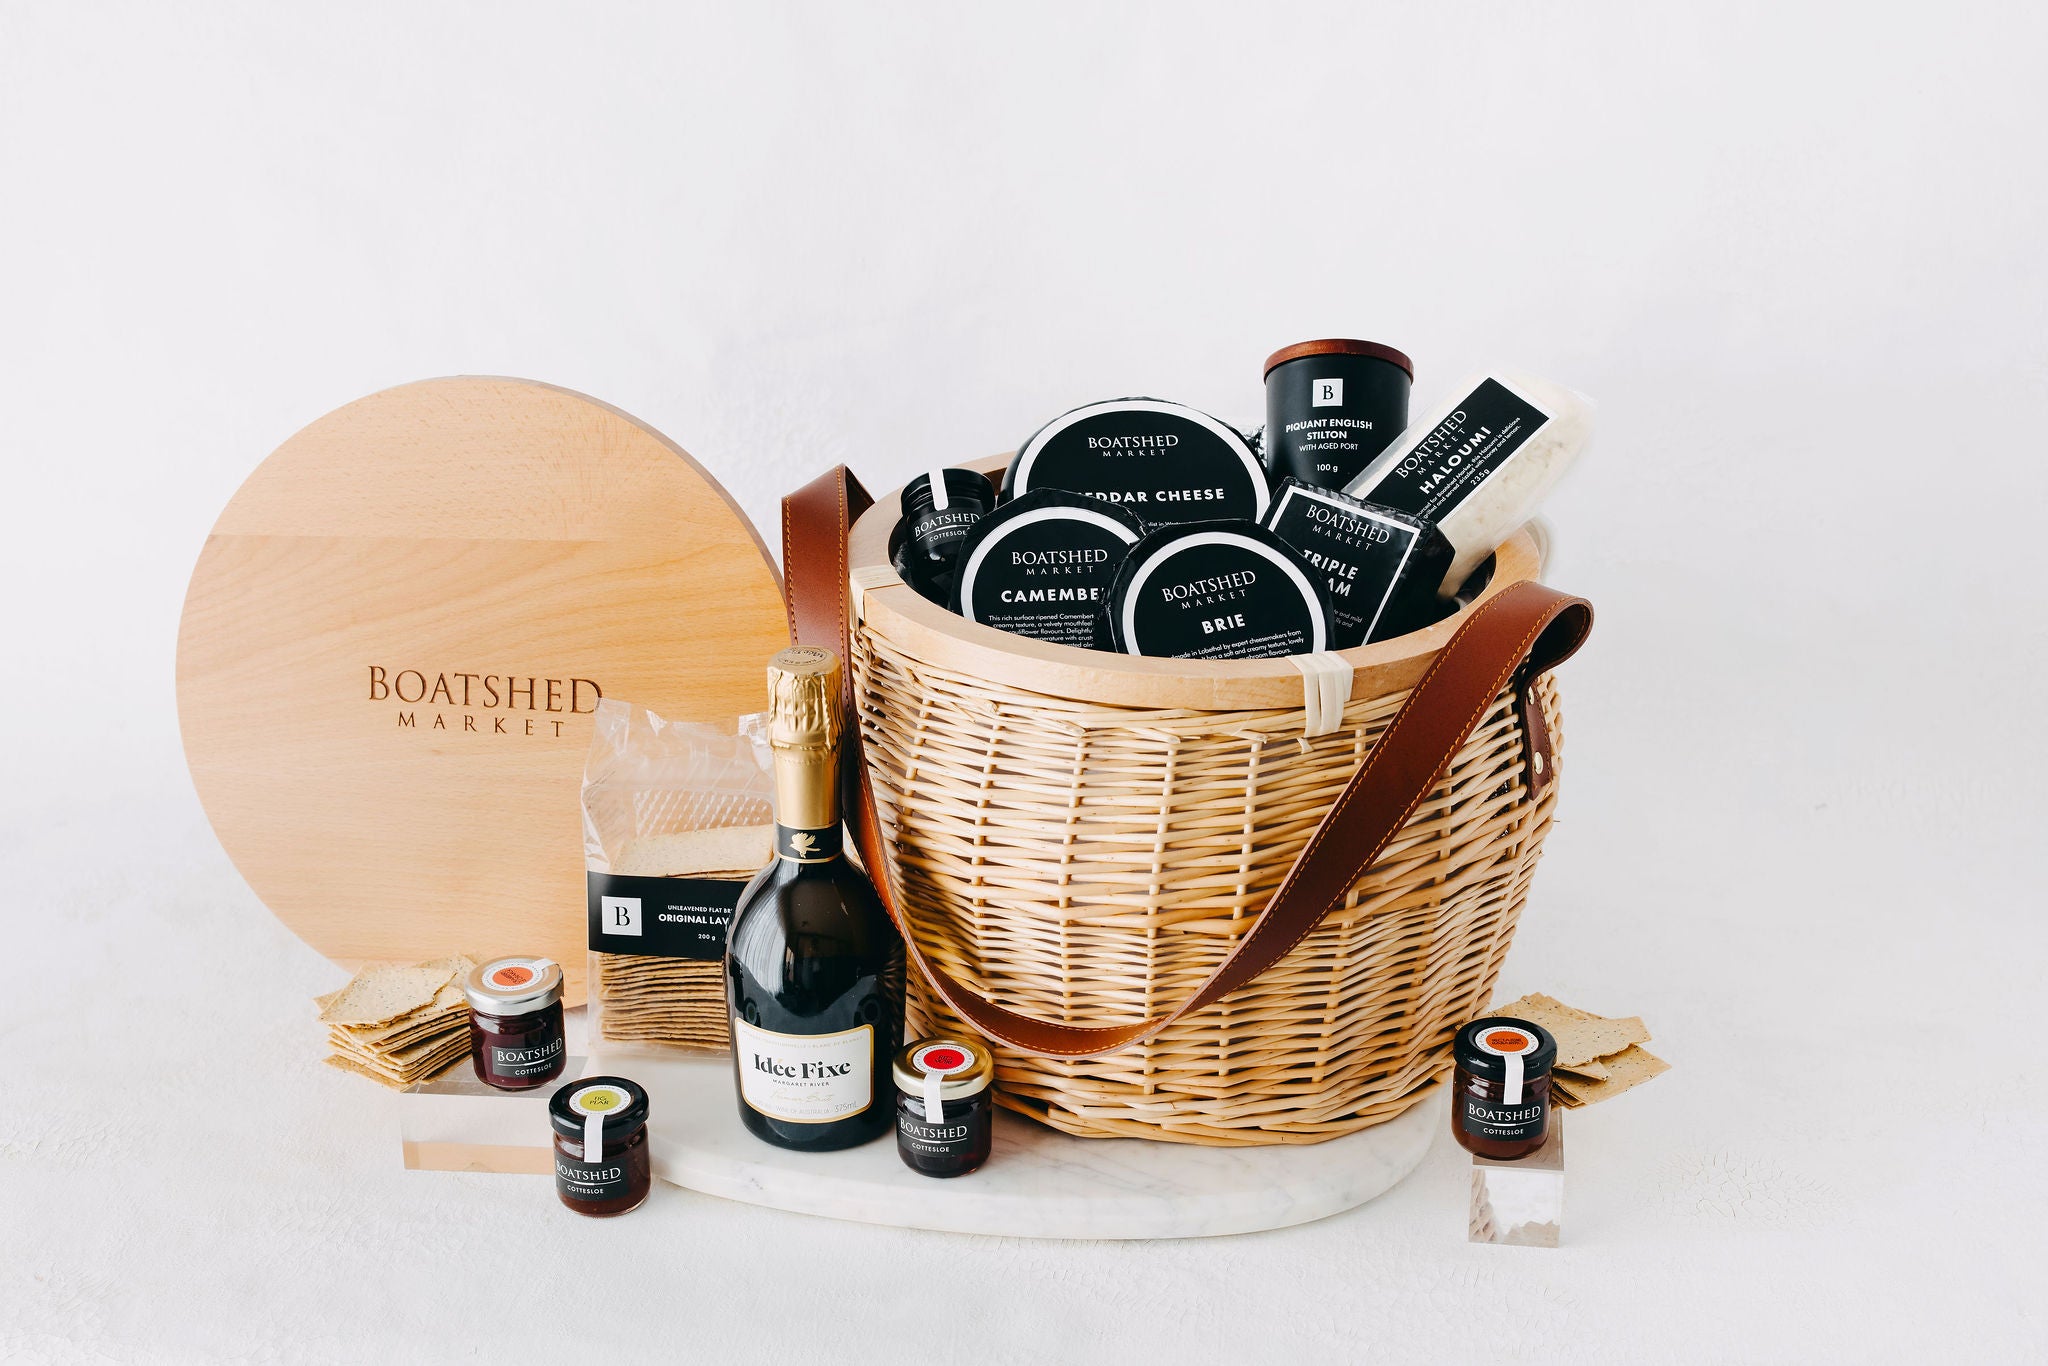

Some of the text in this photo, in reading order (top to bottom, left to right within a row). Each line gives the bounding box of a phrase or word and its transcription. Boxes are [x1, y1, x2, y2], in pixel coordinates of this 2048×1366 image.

[1322, 385, 1334, 400] B
[1286, 418, 1372, 432] PIQUANT ENGLISH
[1088, 435, 1178, 448] BOATSHED
[1306, 430, 1347, 440] STILTON
[1299, 443, 1316, 452] WITH
[1318, 442, 1338, 450] AGED
[1396, 410, 1466, 478] BOATSHED
[1417, 428, 1465, 475] MARKET
[1103, 449, 1166, 457] MARKET
[1420, 426, 1492, 494] HALOUMI
[1470, 469, 1490, 486] 235g
[1155, 488, 1225, 501] CHEESE
[914, 513, 980, 537] BOATSHED
[1306, 504, 1390, 544] BOATSHED
[929, 530, 966, 542] COTTESLOE
[1312, 525, 1372, 551] MARKET
[1012, 549, 1108, 565] BOATSHED
[1304, 549, 1359, 580] TRIPLE
[1026, 566, 1093, 575] MARKET
[1162, 570, 1256, 602] BOATSHED
[1001, 588, 1104, 602] CAMEMBE
[1182, 589, 1246, 609] MARKET
[1201, 613, 1246, 634] BRIE
[368, 666, 602, 714] BOATSHED
[398, 711, 564, 737] MARKET
[614, 906, 630, 926] B
[658, 913, 729, 925] ORIGINAL LAV
[497, 1037, 563, 1062] BOATSHED
[514, 1063, 552, 1076] COTTESLOE
[801, 1061, 851, 1079] Fixe
[772, 1079, 807, 1087] MARGARET
[1469, 1103, 1540, 1121] BOATSHED
[900, 1118, 967, 1138] BOATSHED
[912, 1142, 950, 1153] COTTESLOE
[567, 1185, 604, 1194] COTTESLOE
